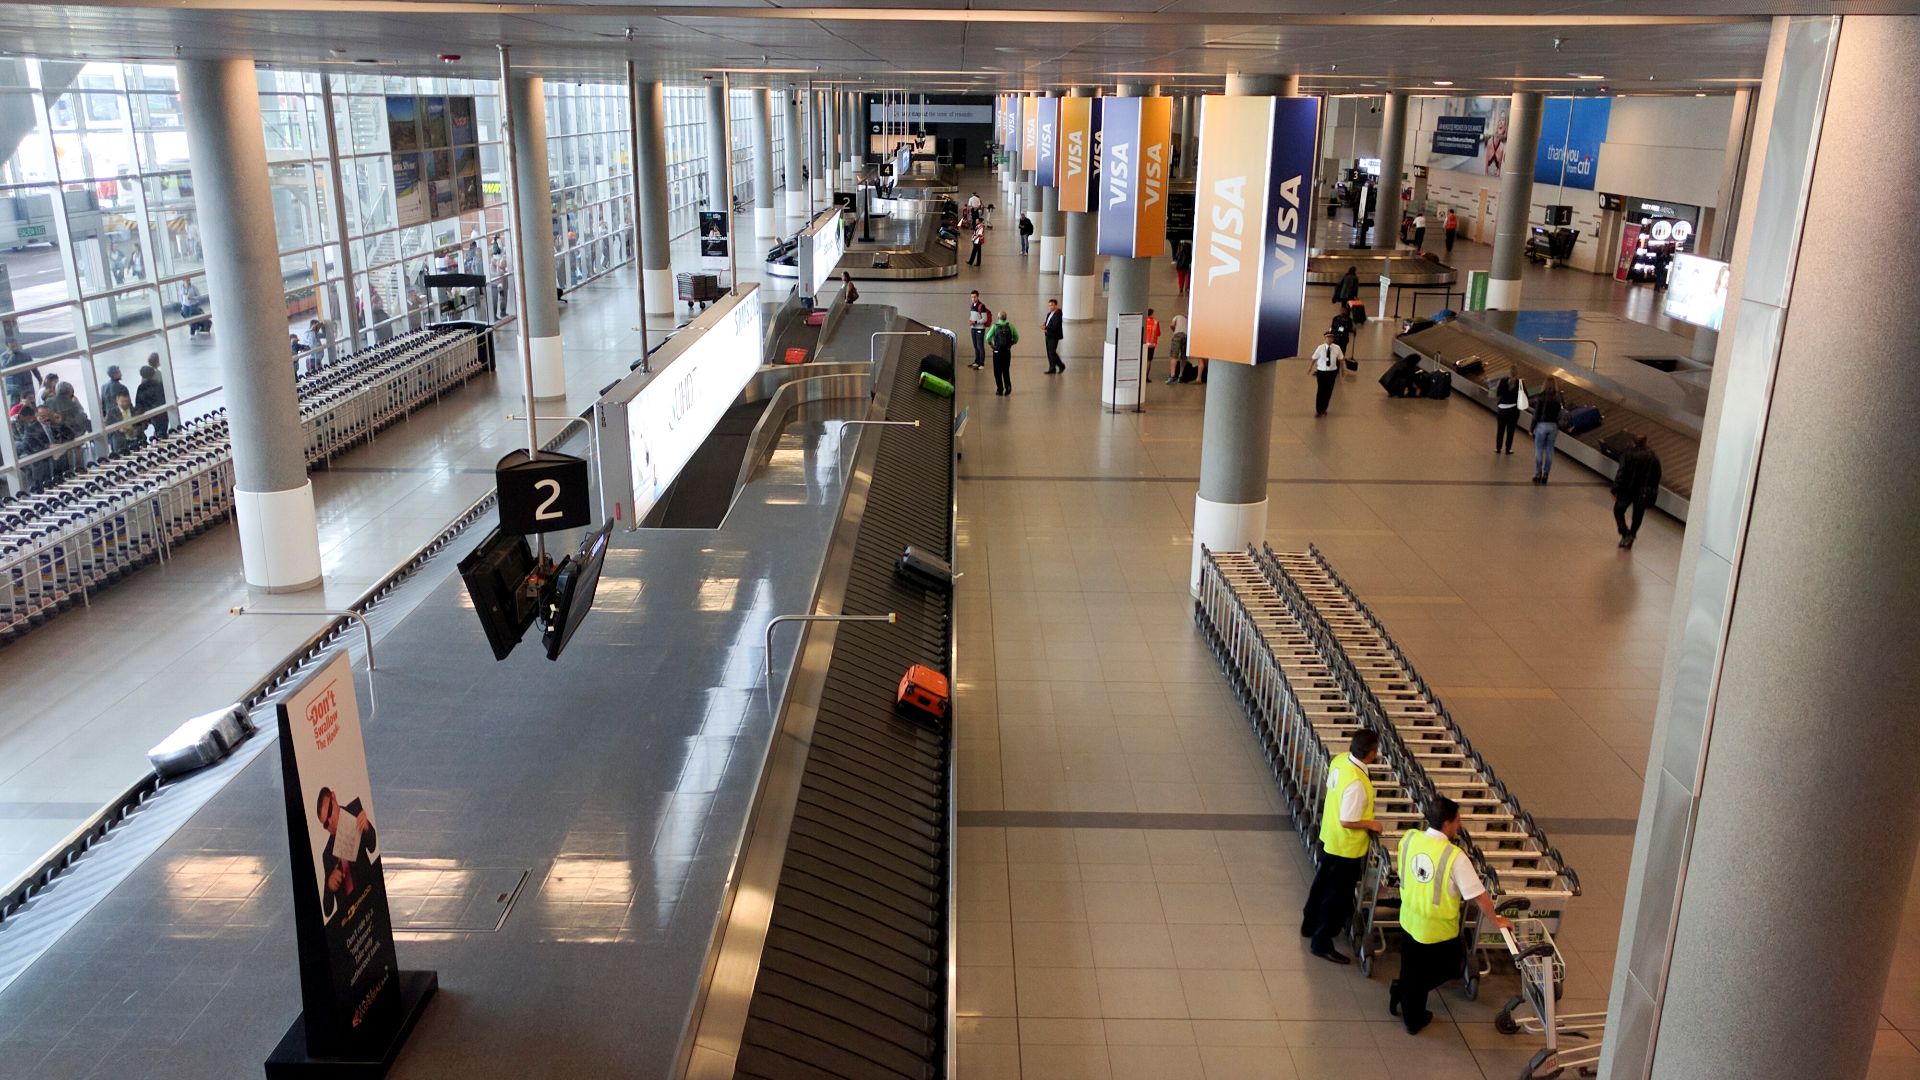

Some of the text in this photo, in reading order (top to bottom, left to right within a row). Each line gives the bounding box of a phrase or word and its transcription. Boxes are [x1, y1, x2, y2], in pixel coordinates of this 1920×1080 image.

[1008, 112, 1016, 135] VISA
[1026, 119, 1036, 148] VISA
[1041, 123, 1053, 161] VISA
[1067, 130, 1083, 181] VISA
[1093, 130, 1103, 178] VISA
[884, 165, 891, 175] 4
[1109, 142, 1129, 212] VISA
[1144, 143, 1162, 213] VISA
[1353, 170, 1359, 180] 3
[842, 197, 851, 210] 2
[1546, 209, 1551, 221] 1
[1561, 210, 1568, 223] 1
[1208, 175, 1247, 287] VISA
[1272, 174, 1303, 290] VISA
[533, 479, 564, 521] 2
[310, 689, 337, 726] Don't
[313, 710, 338, 739] Swallow
[316, 738, 327, 750] The
